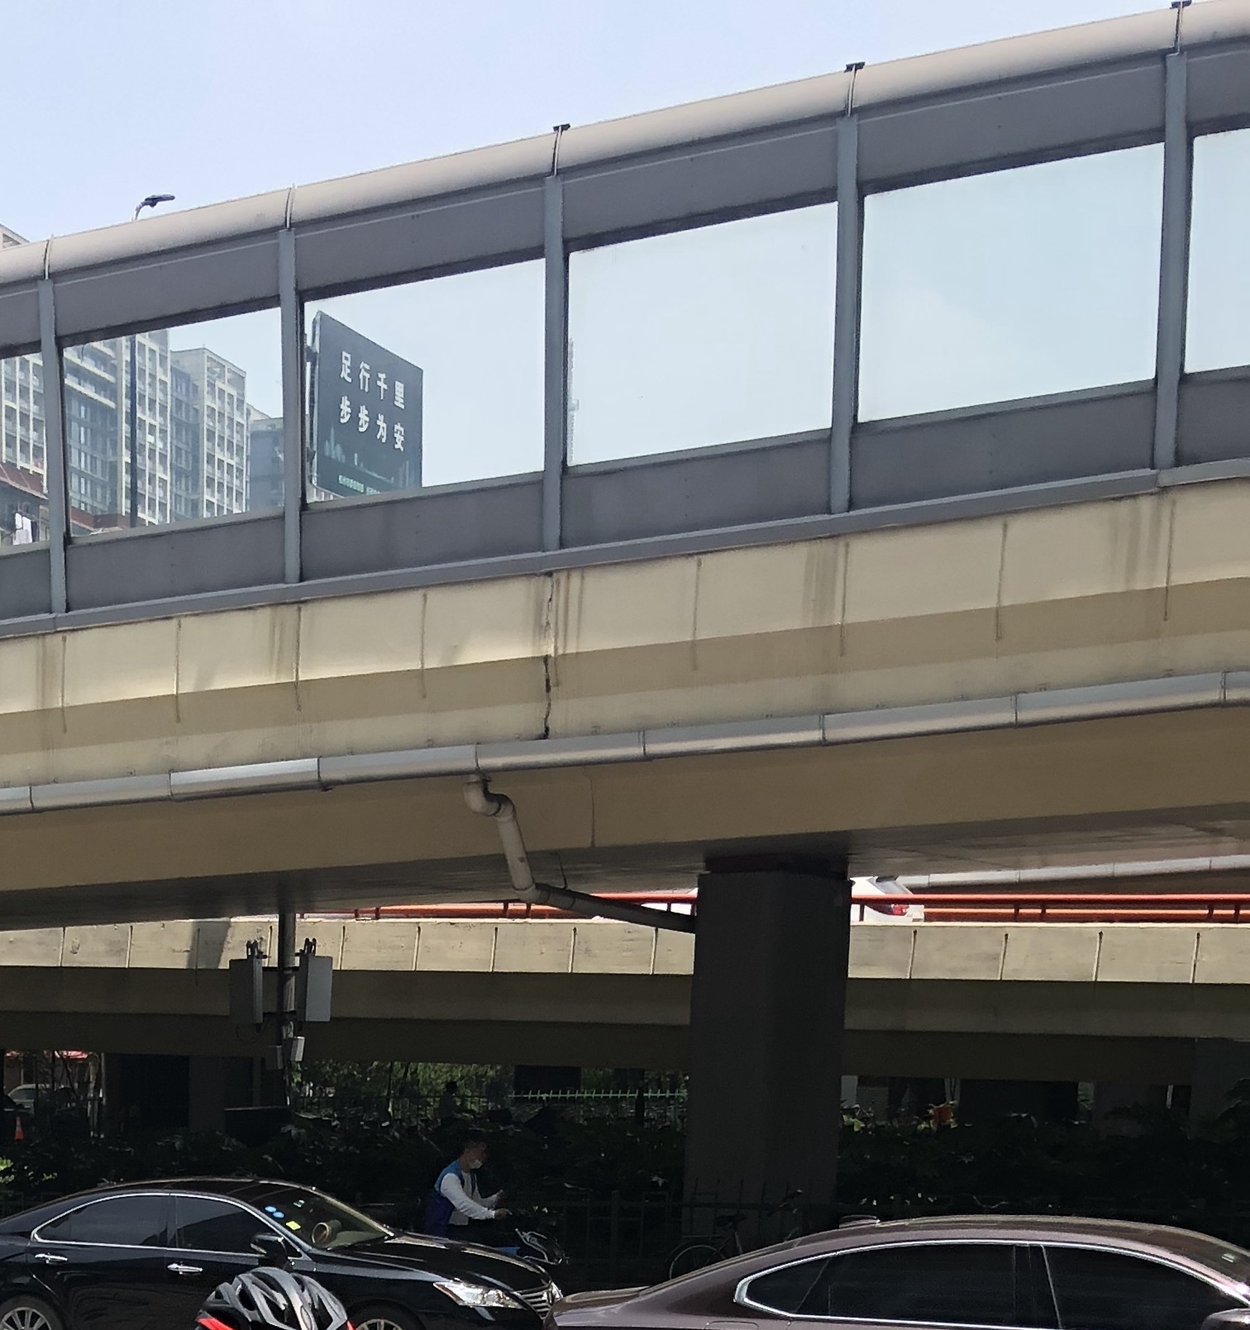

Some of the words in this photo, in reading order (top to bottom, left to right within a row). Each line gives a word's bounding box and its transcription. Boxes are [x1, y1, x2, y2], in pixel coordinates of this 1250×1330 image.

[340, 350, 405, 410] 足行千里
[339, 396, 405, 452] 步步为安
